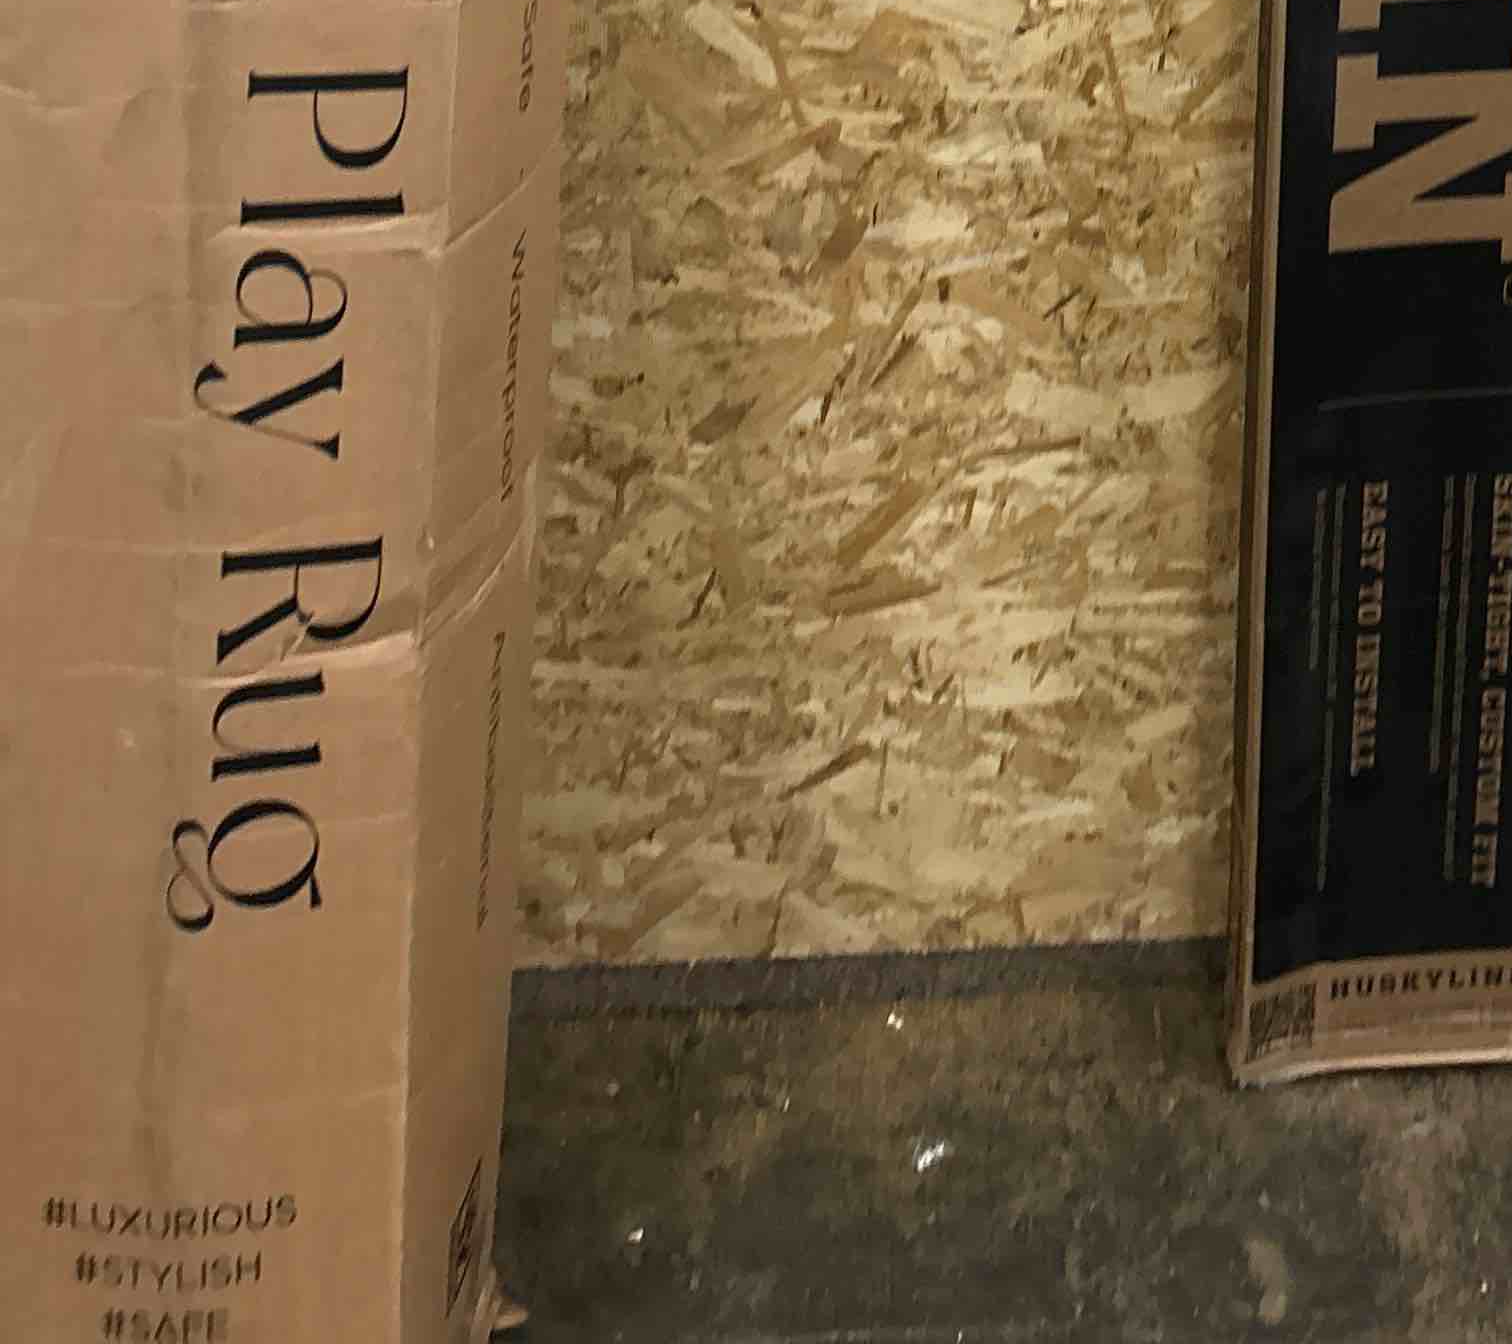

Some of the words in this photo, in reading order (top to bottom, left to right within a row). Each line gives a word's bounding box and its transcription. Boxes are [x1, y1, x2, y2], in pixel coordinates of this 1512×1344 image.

[193, 65, 410, 460] Play
[500, 227, 529, 505] Waterproof
[1360, 480, 1391, 575] EASY
[1356, 578, 1385, 625] TO
[166, 535, 383, 933] Rug
[41, 1193, 298, 1241] #LUXURIOUS
[76, 1251, 263, 1294] #STYLISH
[102, 1307, 229, 1344] #SAFE
